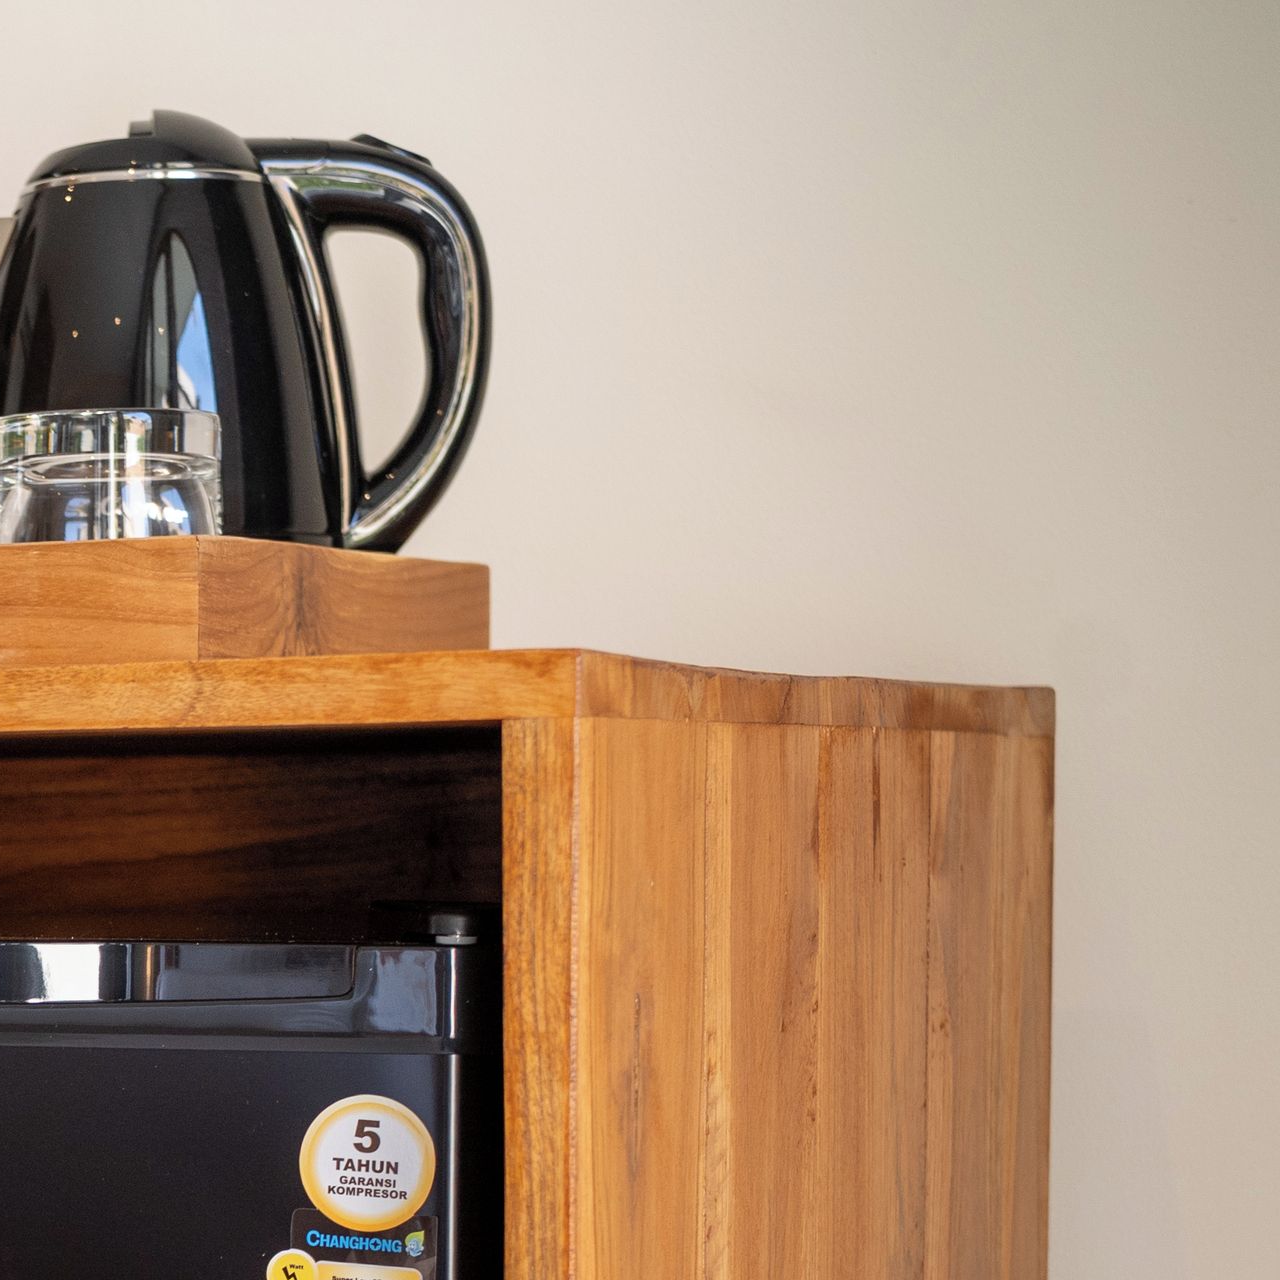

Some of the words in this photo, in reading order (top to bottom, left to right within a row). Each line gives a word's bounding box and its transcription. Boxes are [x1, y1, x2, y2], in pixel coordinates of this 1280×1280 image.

[353, 1119, 381, 1154] 5
[332, 1157, 399, 1175] TAHUN
[339, 1175, 396, 1188] GARANSI
[327, 1185, 407, 1200] KOMPRESOR
[306, 1229, 402, 1254] CHANGHONG
